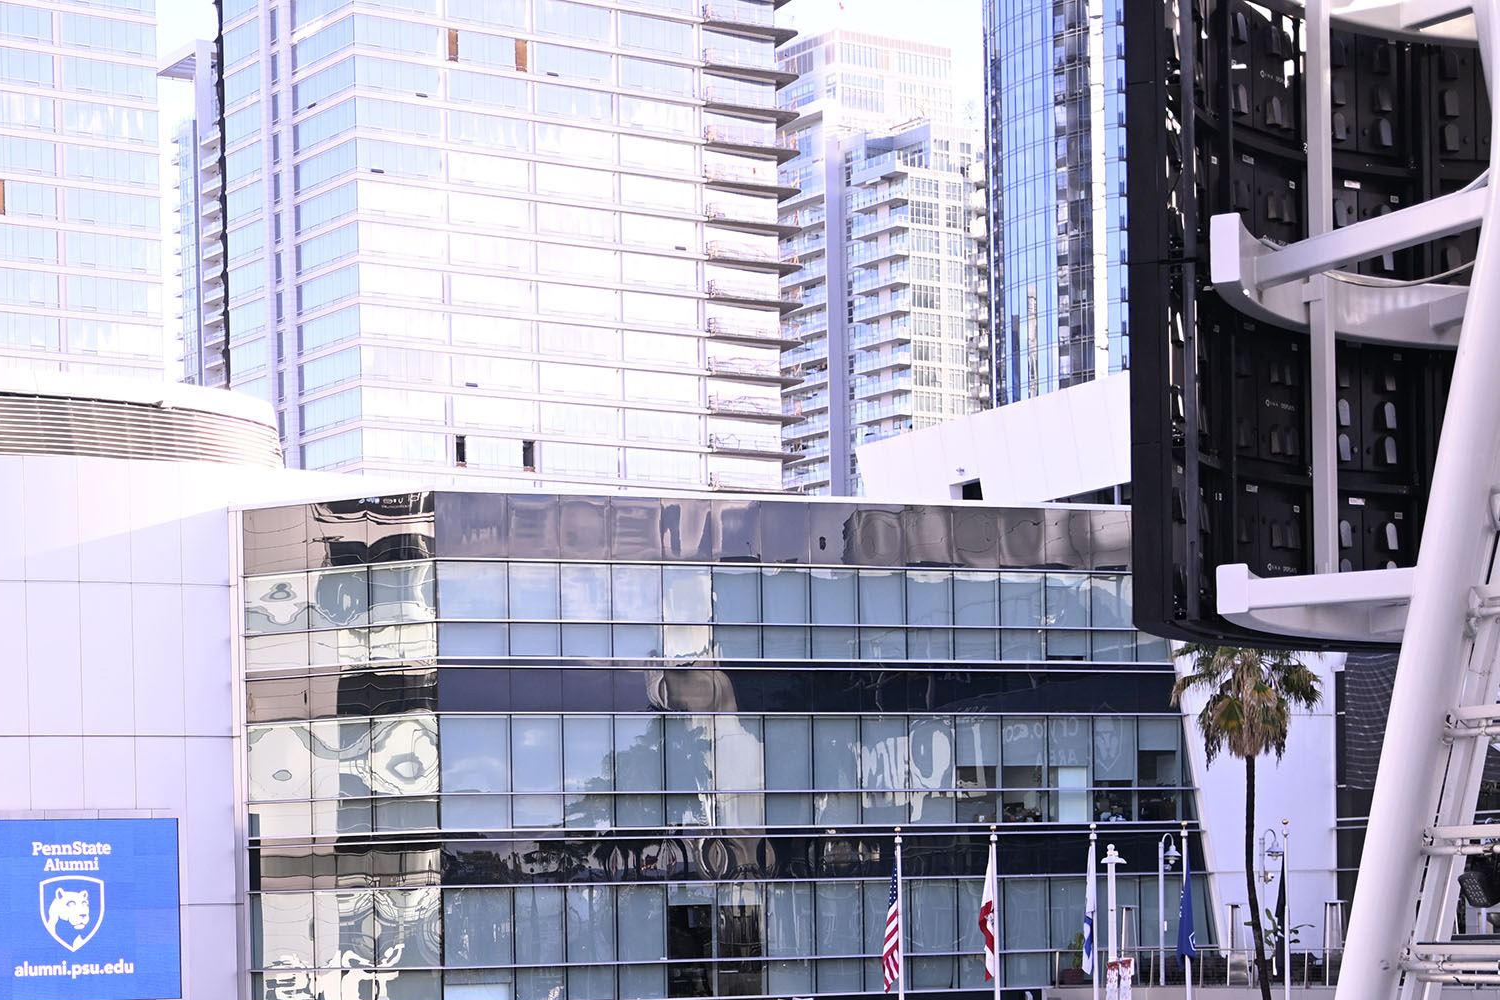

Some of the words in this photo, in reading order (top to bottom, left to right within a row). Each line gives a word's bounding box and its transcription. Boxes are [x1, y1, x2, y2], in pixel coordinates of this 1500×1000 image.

[32, 841, 112, 856] PennState
[44, 857, 99, 871] Alumni
[14, 958, 135, 979] alumni.psu.edu
